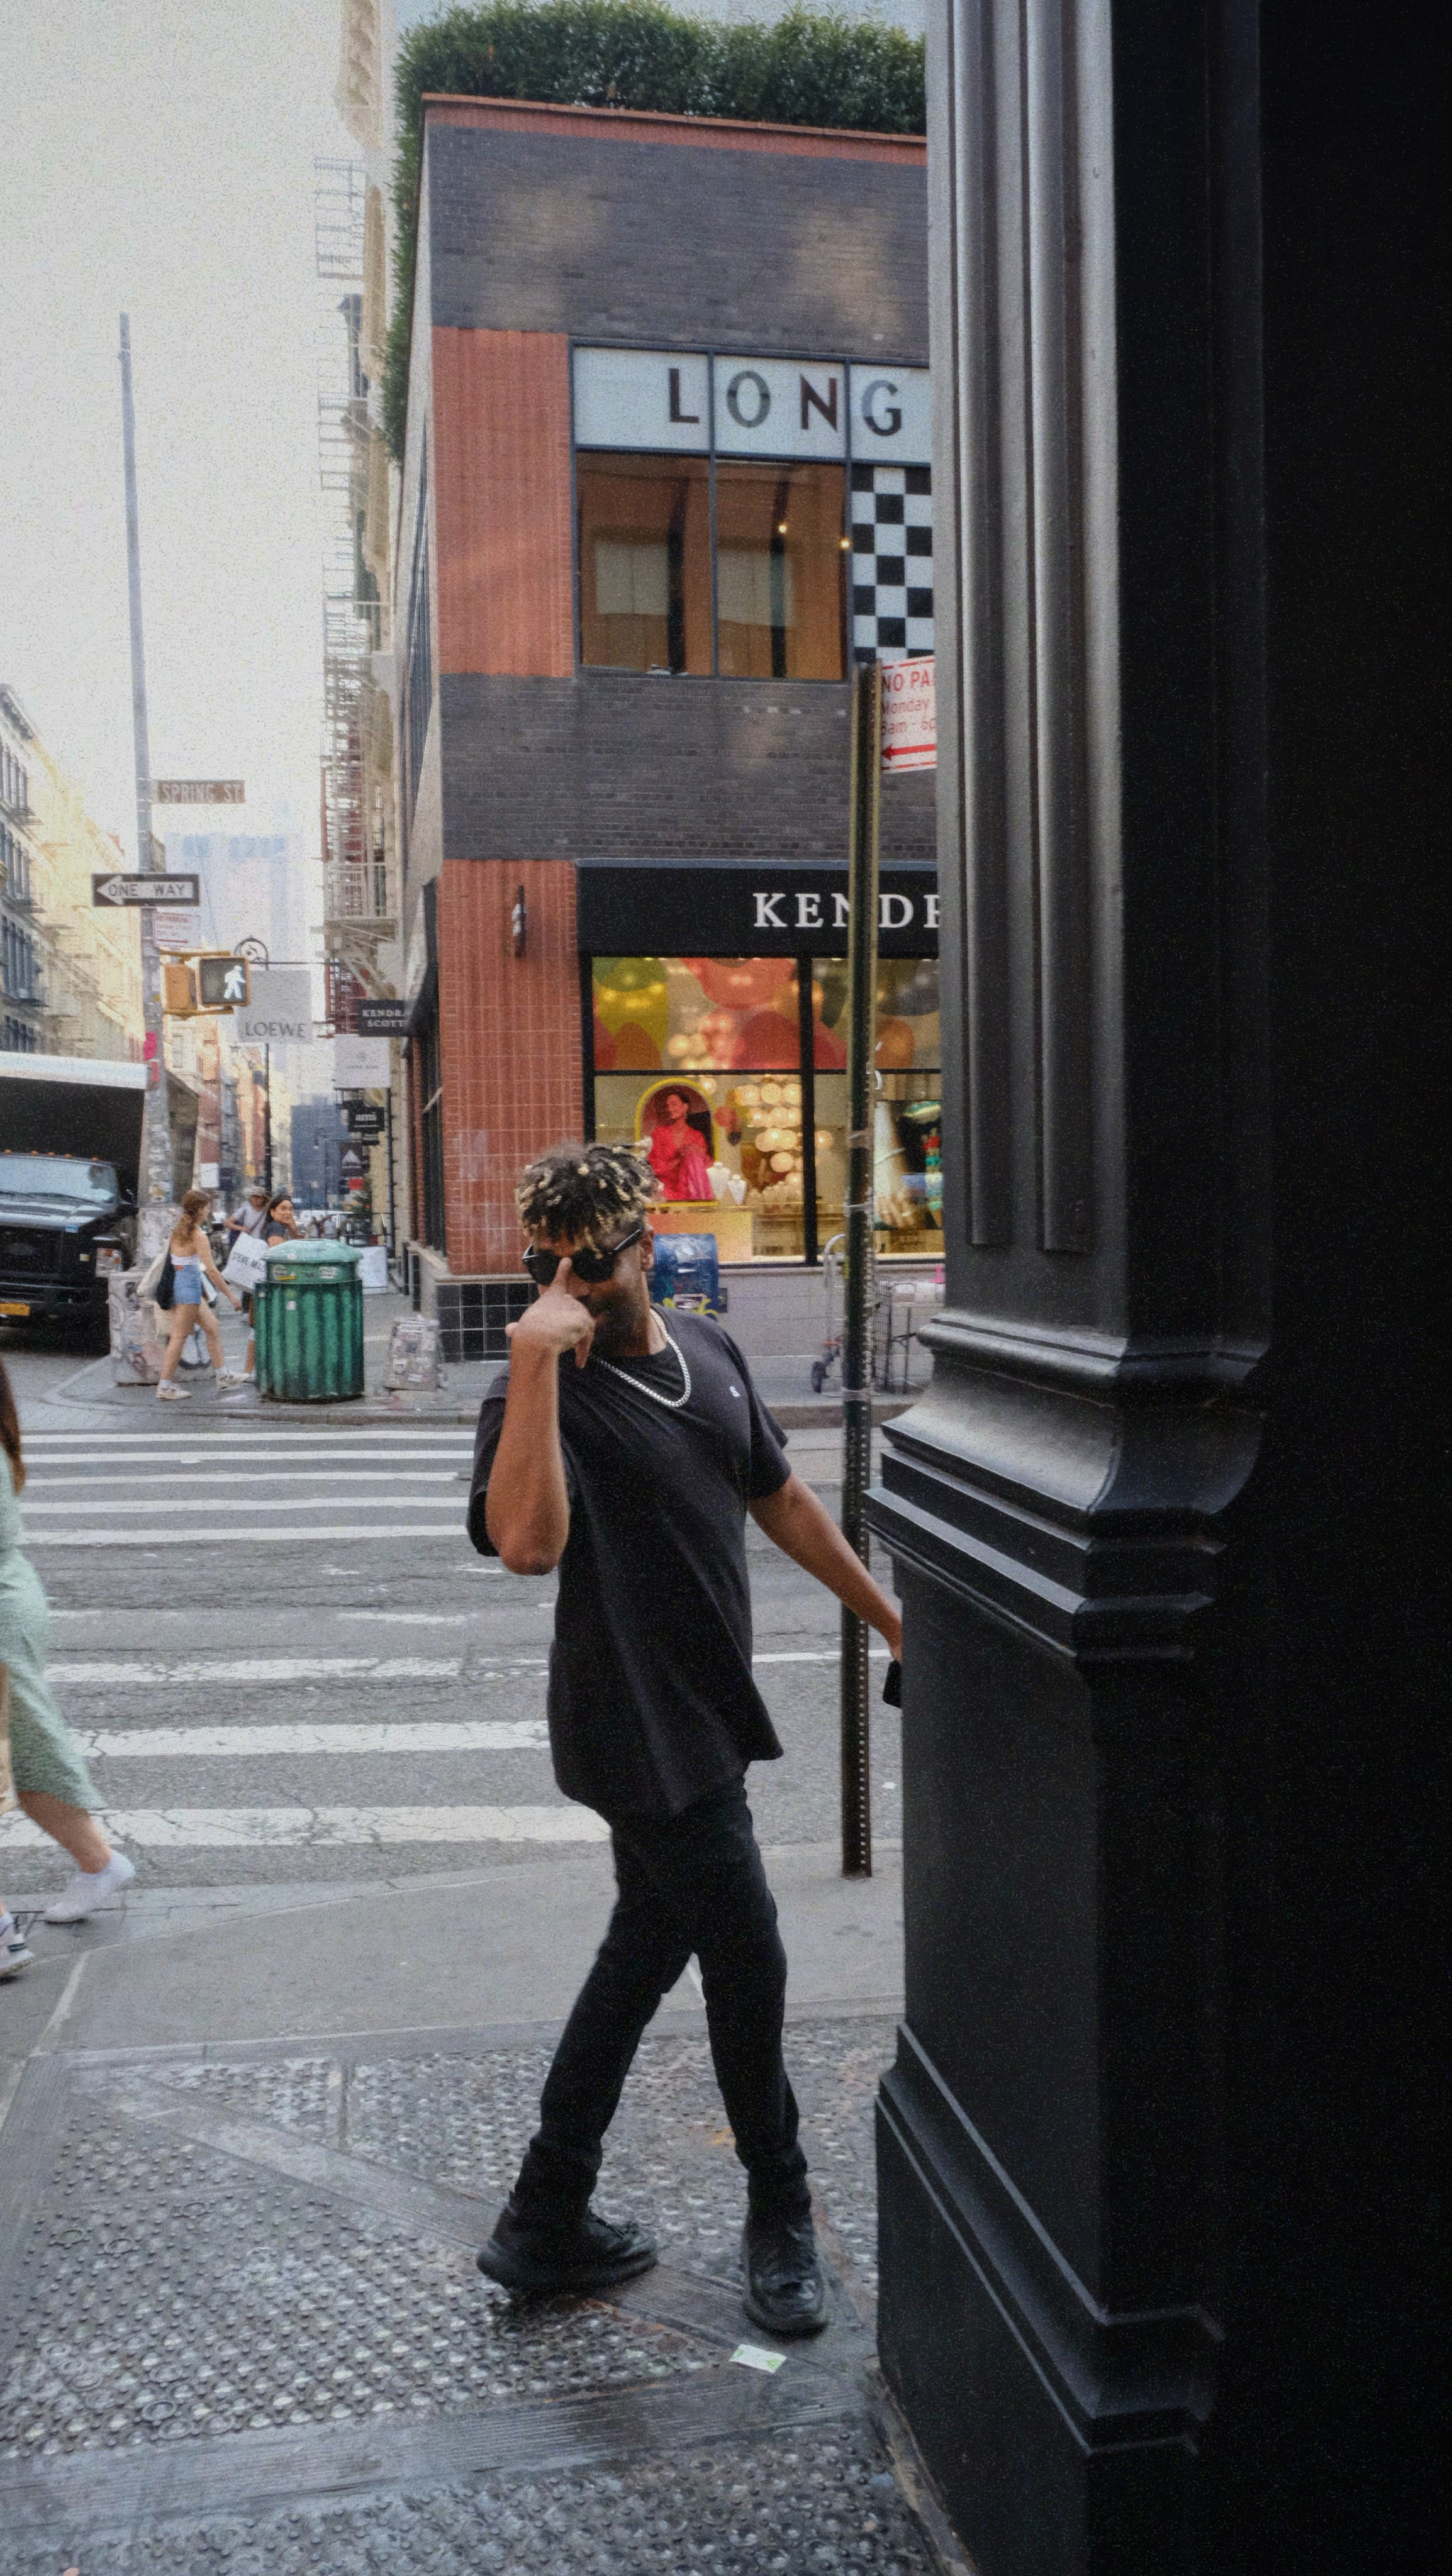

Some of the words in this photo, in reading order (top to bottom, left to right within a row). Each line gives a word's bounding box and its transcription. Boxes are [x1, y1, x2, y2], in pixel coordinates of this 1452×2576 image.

[669, 368, 902, 436] LONG
[882, 674, 903, 692] NO
[162, 784, 215, 802] SPRING
[224, 784, 241, 802] ST
[108, 884, 138, 897] ONE
[154, 884, 184, 897] WAY
[245, 1021, 306, 1038] LOEWE
